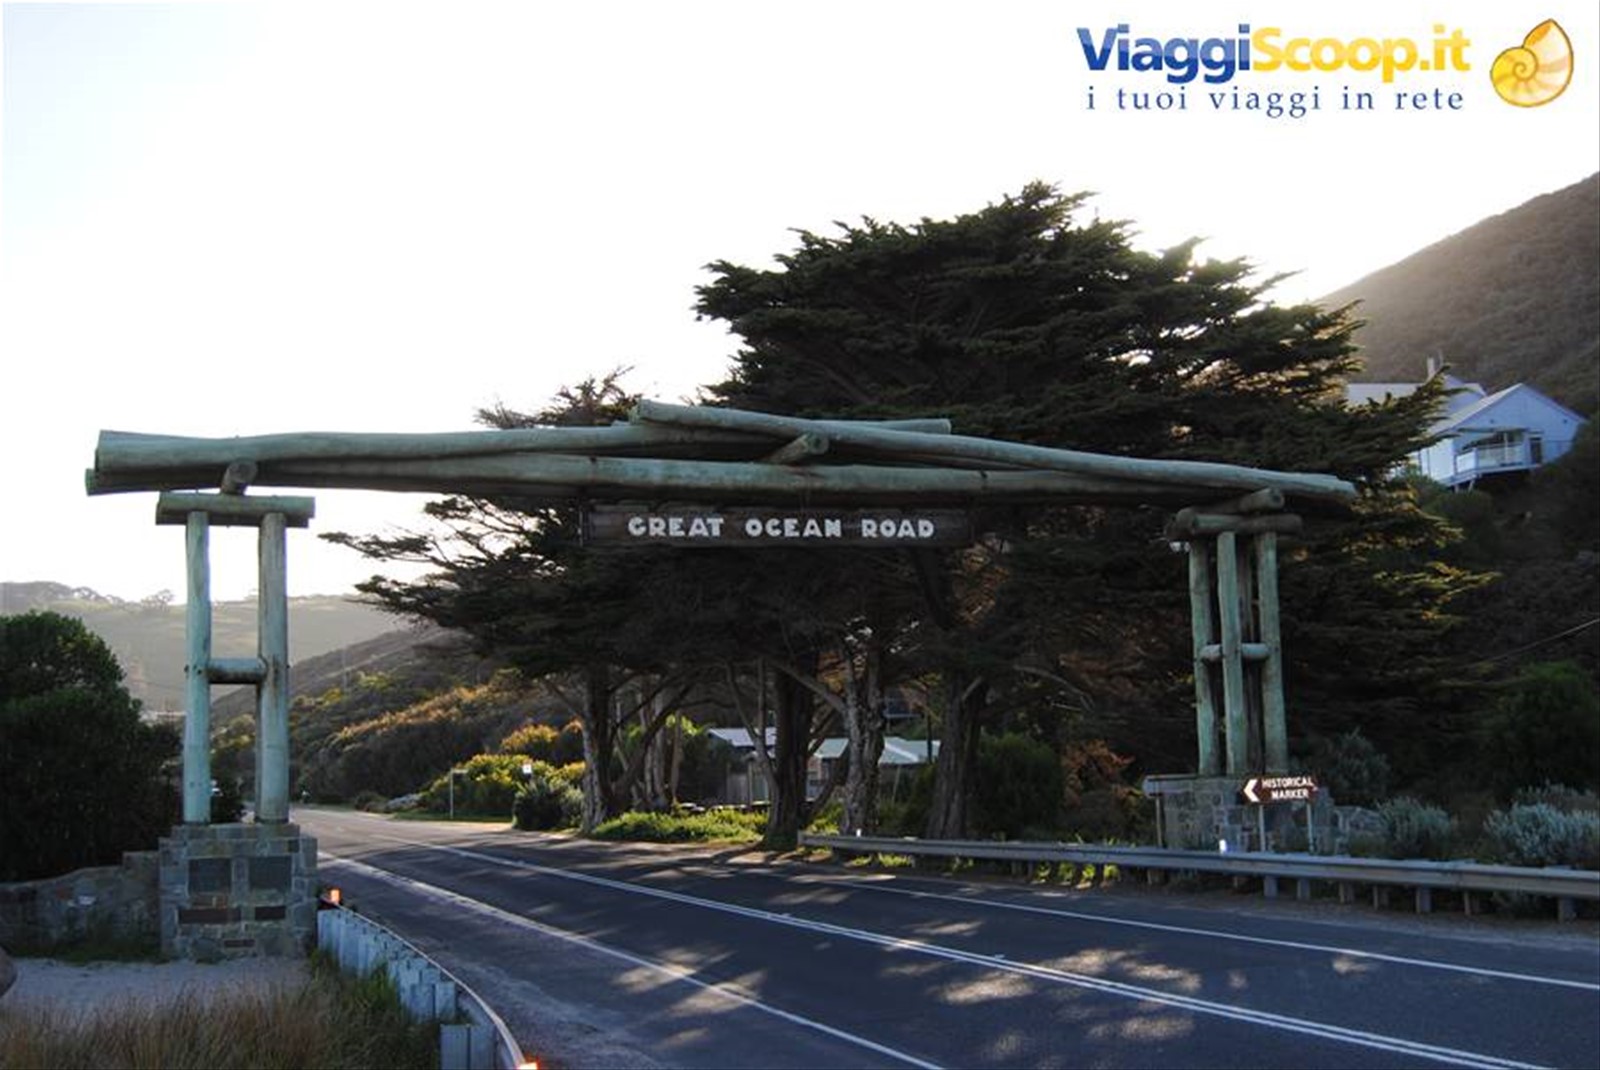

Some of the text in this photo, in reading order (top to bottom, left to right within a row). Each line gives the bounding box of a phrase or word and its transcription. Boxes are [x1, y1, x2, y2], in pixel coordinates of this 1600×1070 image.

[628, 517, 935, 538] GREAT OCEAN ROAD
[1261, 776, 1315, 788] HISTORICAL
[1271, 788, 1309, 799] MARKER
